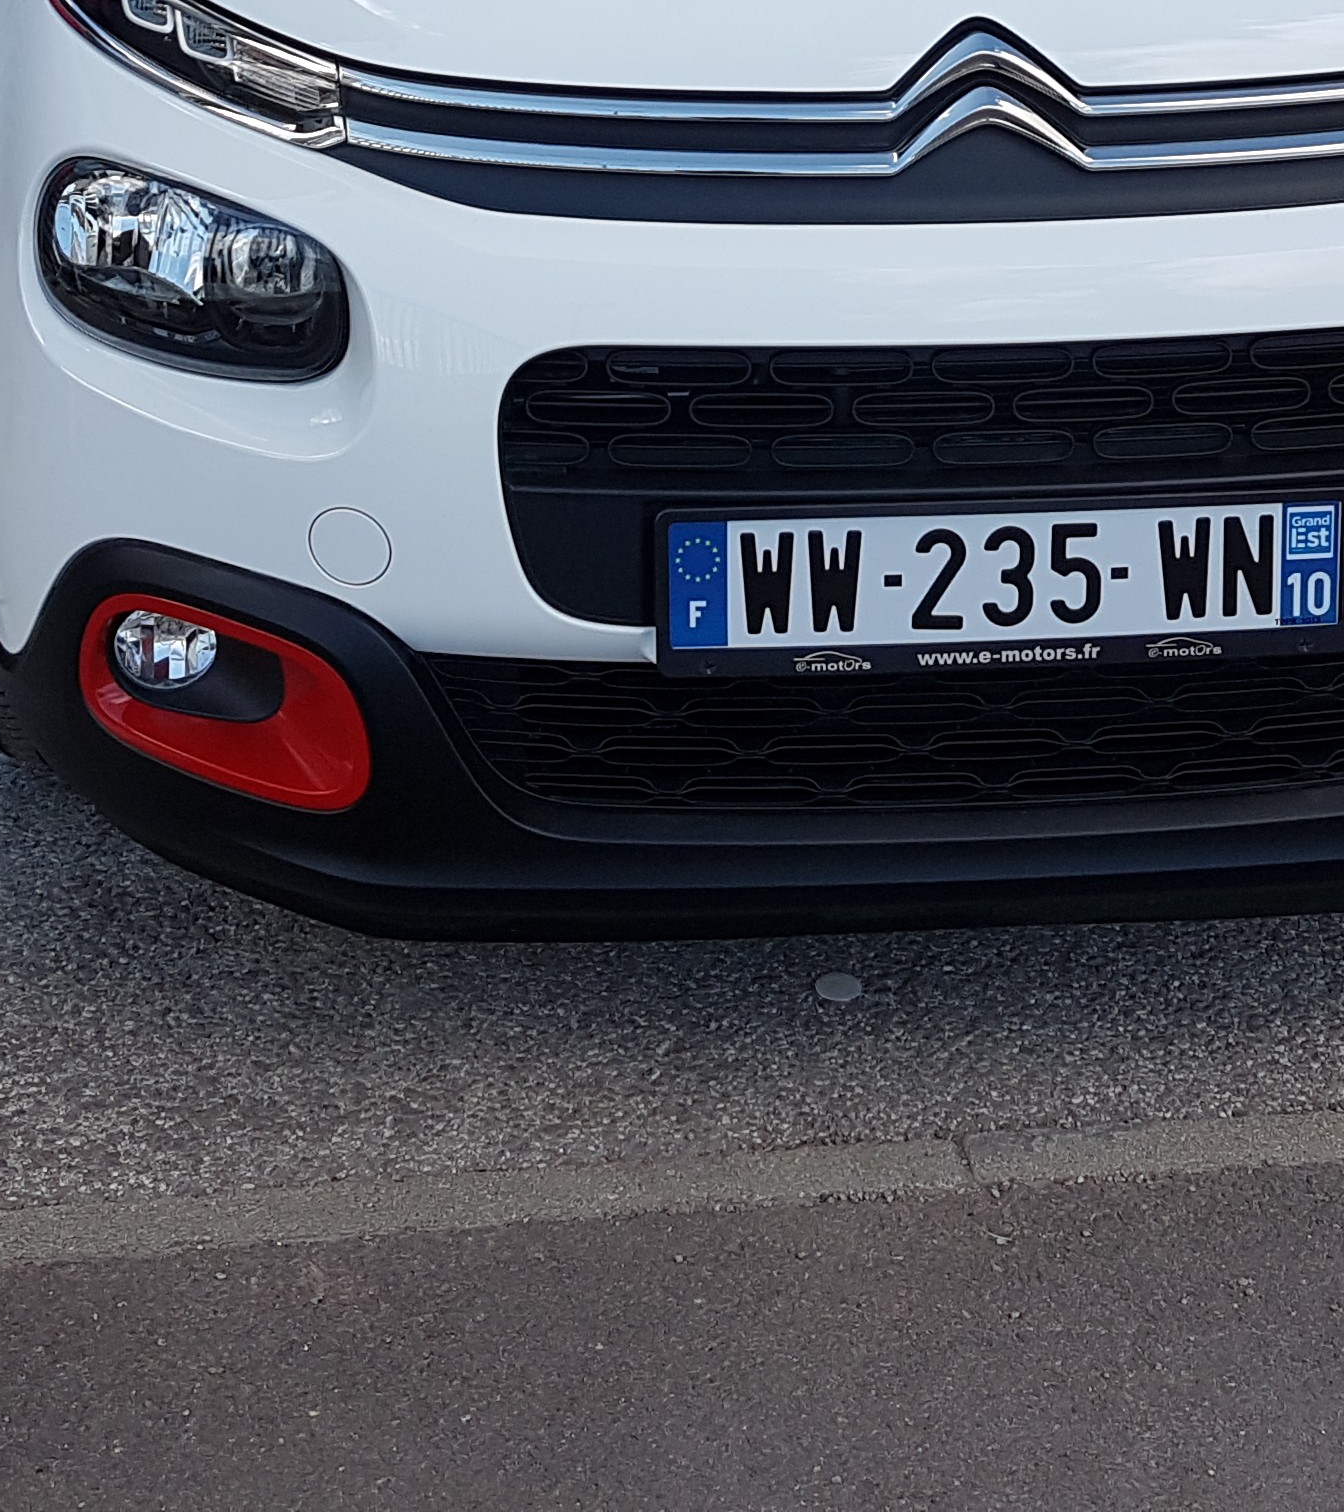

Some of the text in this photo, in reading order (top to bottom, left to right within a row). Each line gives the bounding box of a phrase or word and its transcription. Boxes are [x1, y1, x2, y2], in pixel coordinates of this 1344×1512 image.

[1291, 514, 1331, 527] Grand
[1290, 527, 1330, 548] Est
[1286, 571, 1332, 617] 10
[689, 600, 707, 628] F
[916, 642, 1101, 667] www.e-motors.fr
